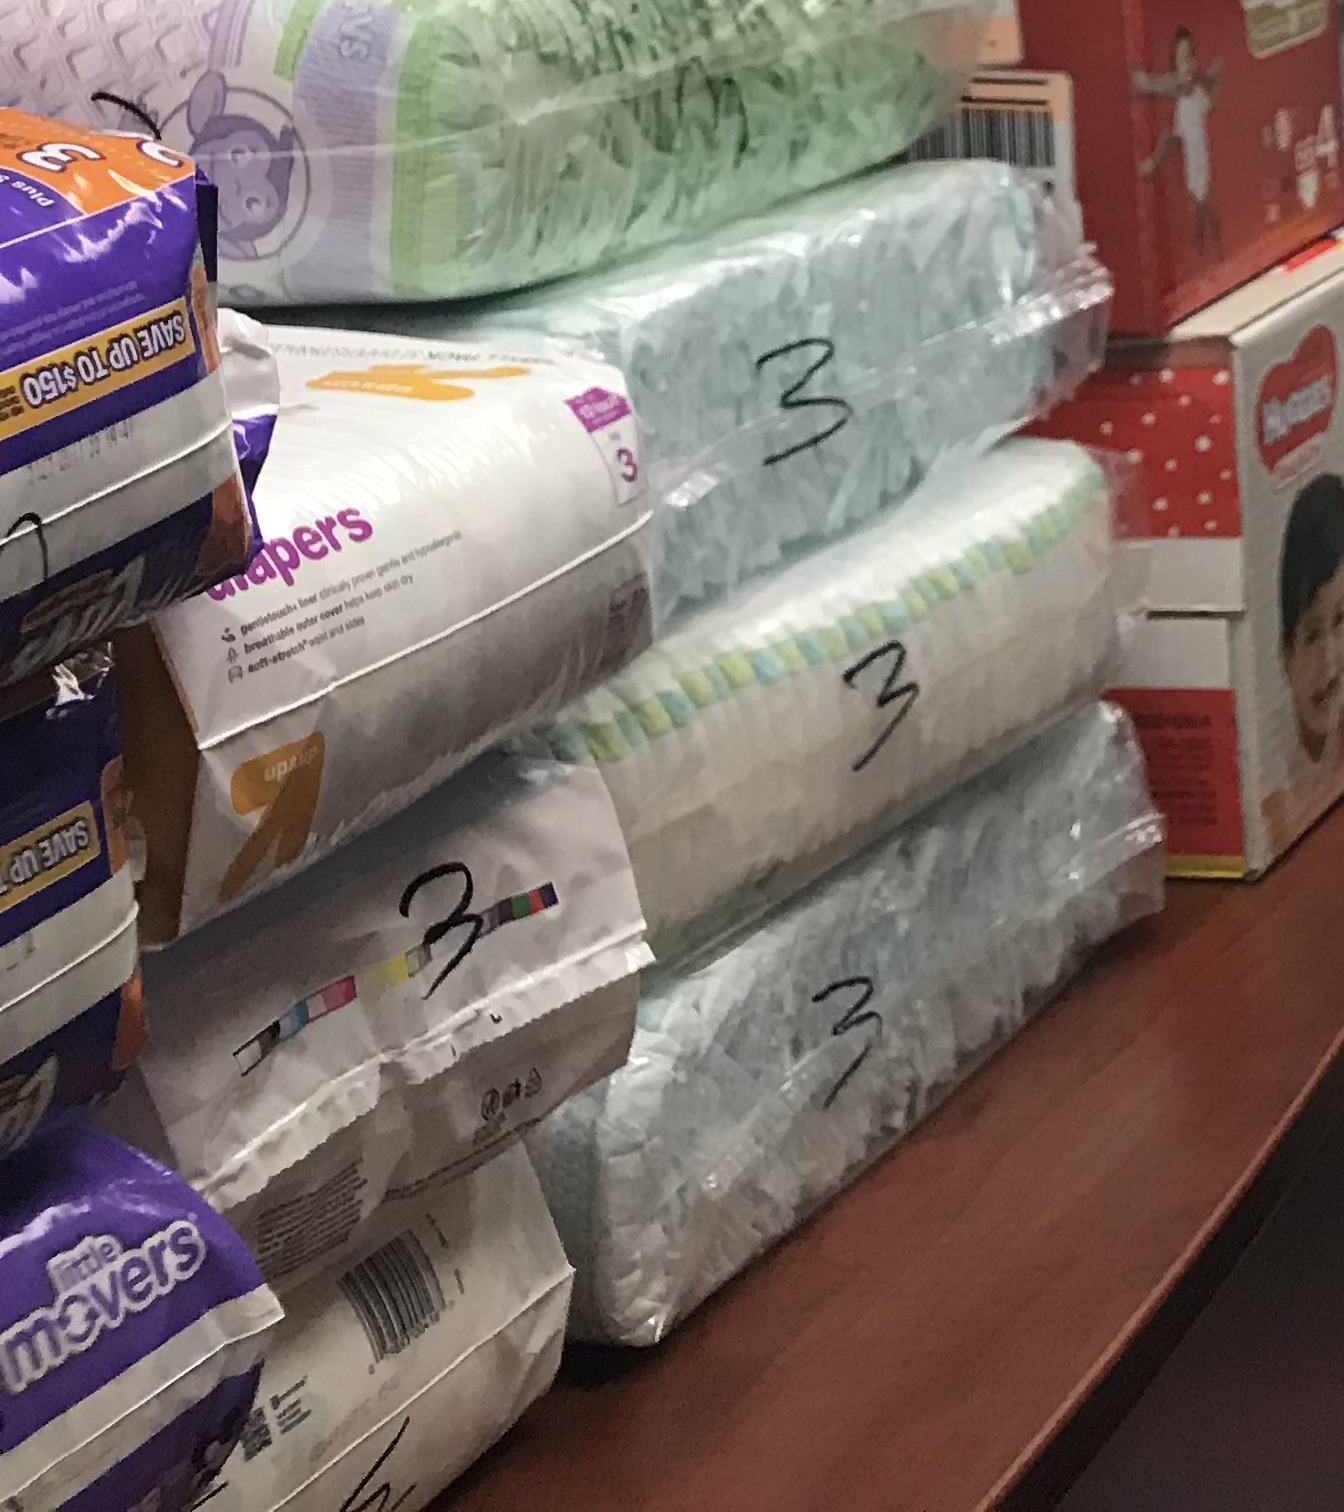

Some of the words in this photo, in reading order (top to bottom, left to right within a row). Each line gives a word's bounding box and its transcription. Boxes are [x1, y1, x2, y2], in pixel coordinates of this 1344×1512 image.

[17, 142, 104, 175] 3
[12, 179, 55, 209] Plus
[105, 336, 139, 371] UP
[135, 314, 188, 359] SAVE
[20, 361, 78, 406] $150
[75, 350, 107, 384] TO
[756, 337, 854, 467] 3
[616, 448, 638, 483] 3
[320, 605, 344, 620] cover
[842, 639, 921, 773] 3
[38, 819, 90, 868] SAVE
[8, 849, 40, 884] UP
[398, 861, 485, 1001] 3
[5, 1224, 202, 1384] movers
